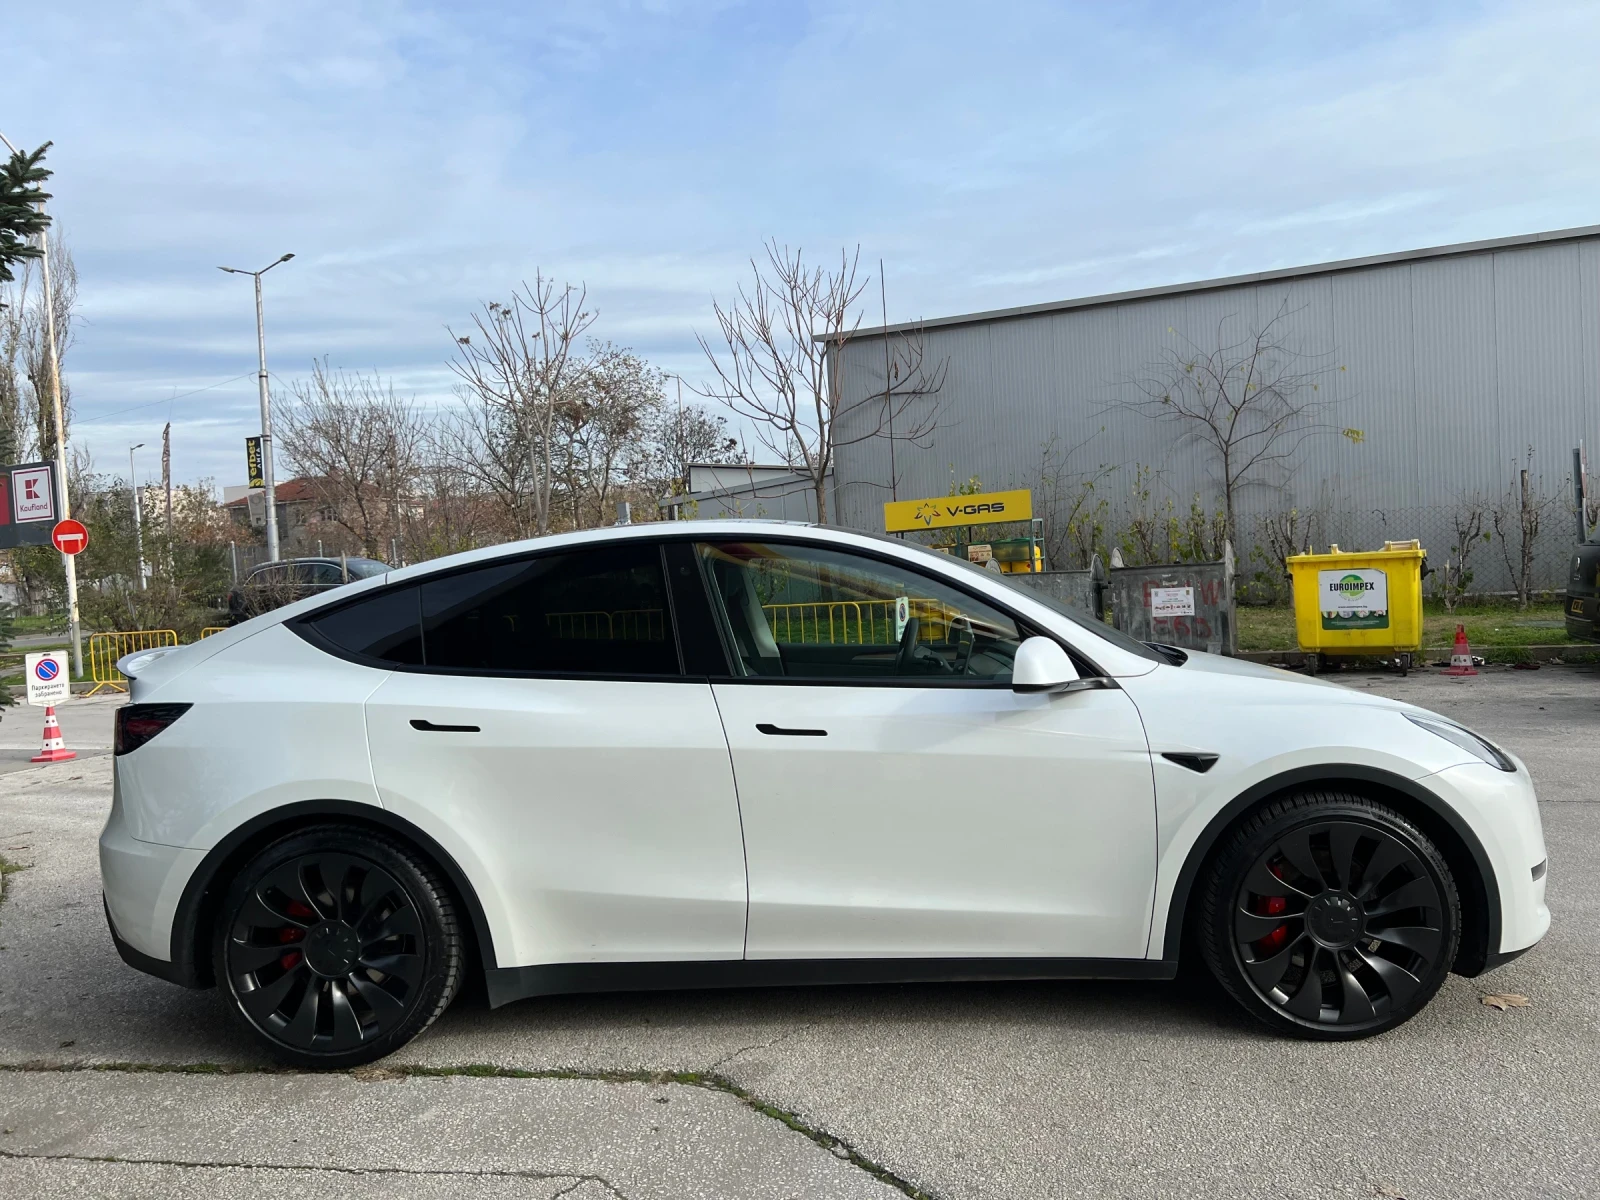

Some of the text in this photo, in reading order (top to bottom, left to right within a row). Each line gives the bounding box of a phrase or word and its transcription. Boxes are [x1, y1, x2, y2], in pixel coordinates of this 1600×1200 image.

[248, 439, 257, 477] efbet
[25, 478, 40, 500] K
[20, 502, 48, 512] Kaufland
[946, 503, 1004, 517] V-GAS
[1329, 582, 1375, 592] EUROIMPEX
[31, 683, 65, 691] Паркирането
[35, 690, 63, 698] забранено
